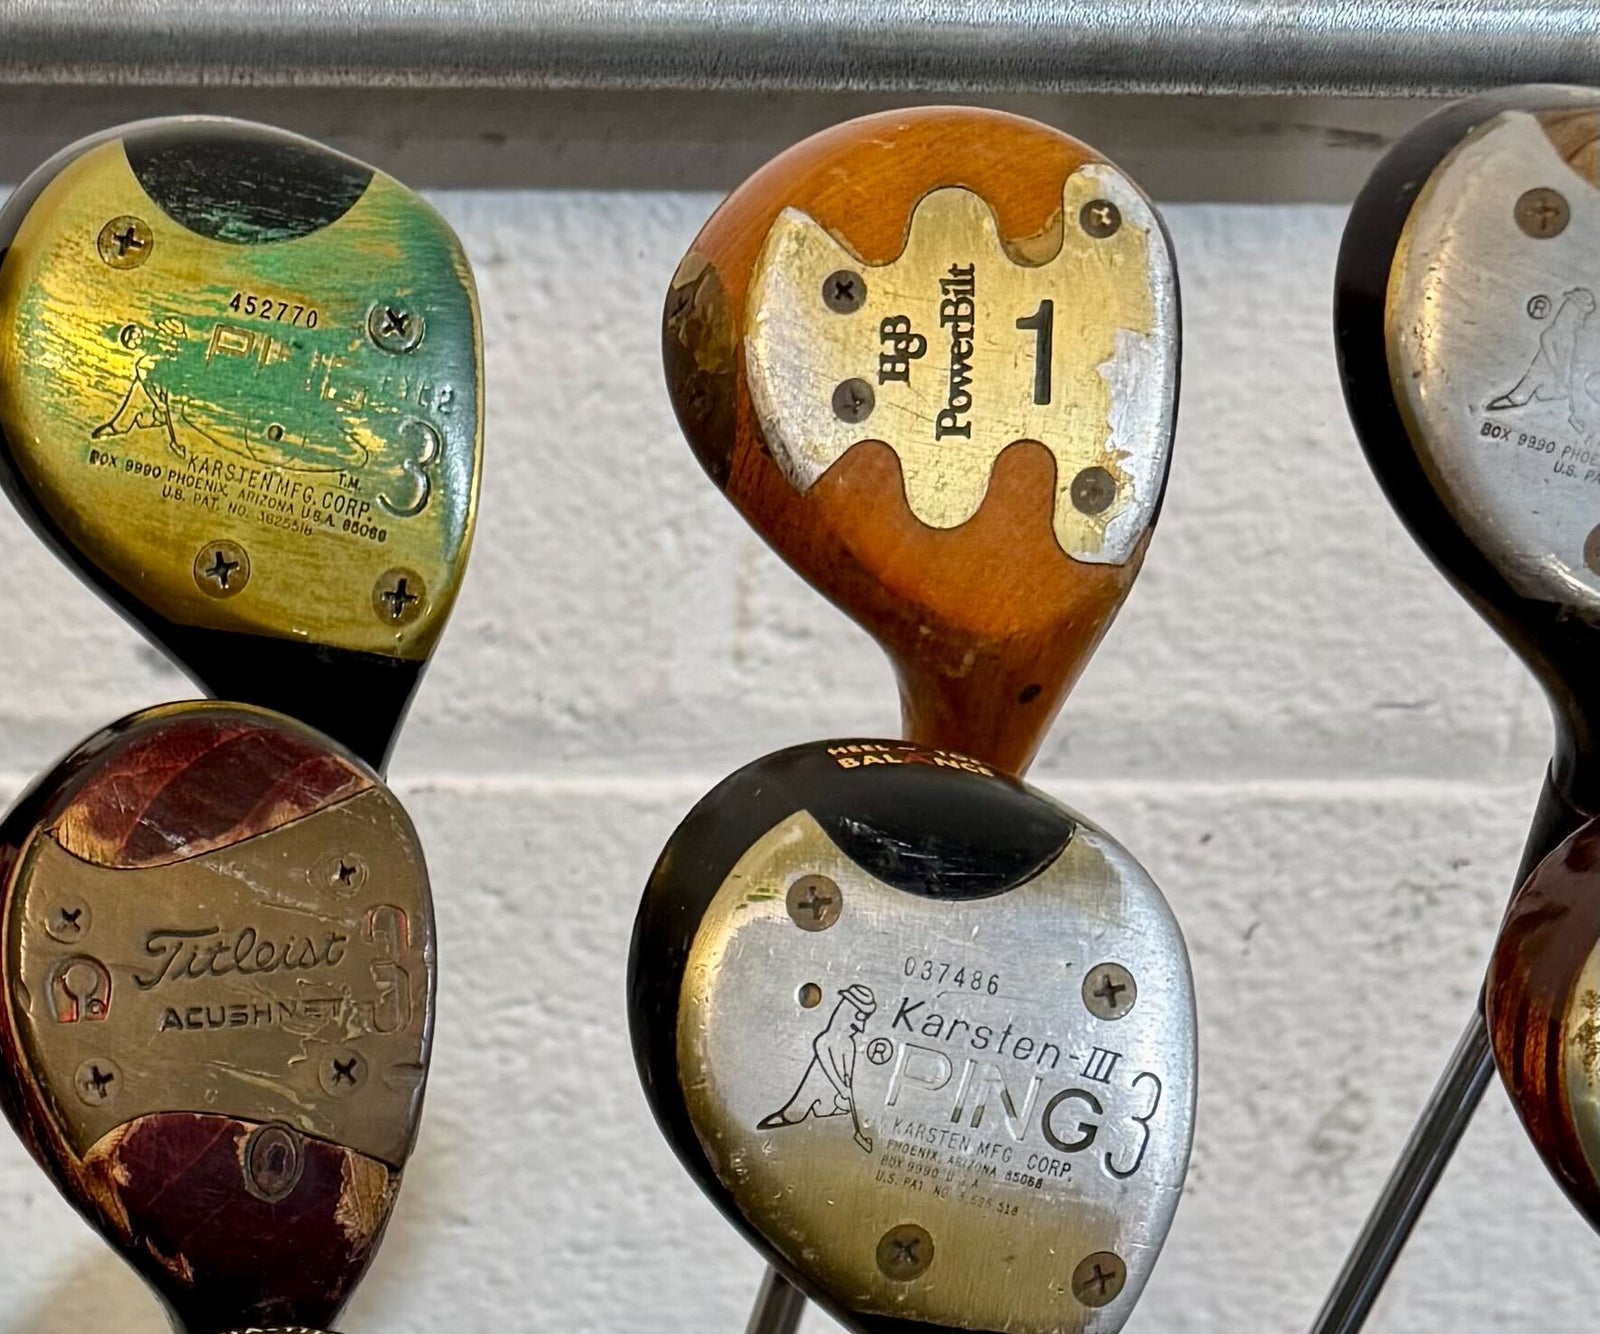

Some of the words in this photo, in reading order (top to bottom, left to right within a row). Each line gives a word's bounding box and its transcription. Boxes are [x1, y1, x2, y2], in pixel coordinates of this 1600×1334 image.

[229, 292, 318, 328] 452770
[935, 262, 975, 442] PowerBilt
[1015, 298, 1054, 406] 1
[1480, 421, 1512, 441] BOX
[1517, 433, 1556, 454] 9990
[188, 453, 274, 493] KARSTEN
[276, 475, 316, 506] MFG.
[322, 491, 372, 523] CORP.
[338, 473, 361, 491] T.M.
[377, 417, 443, 517] 3
[1553, 460, 1577, 478] U.S.
[227, 502, 249, 519] NO.
[237, 489, 294, 515] ARIZONA
[837, 754, 994, 778] BALANCE
[133, 925, 347, 990] Titleist
[903, 956, 999, 996] 037486
[885, 1043, 1103, 1152] PING
[893, 1117, 970, 1152] KARSTEN
[1027, 1153, 1073, 1182] CORP.
[1104, 1071, 1161, 1180] 3
